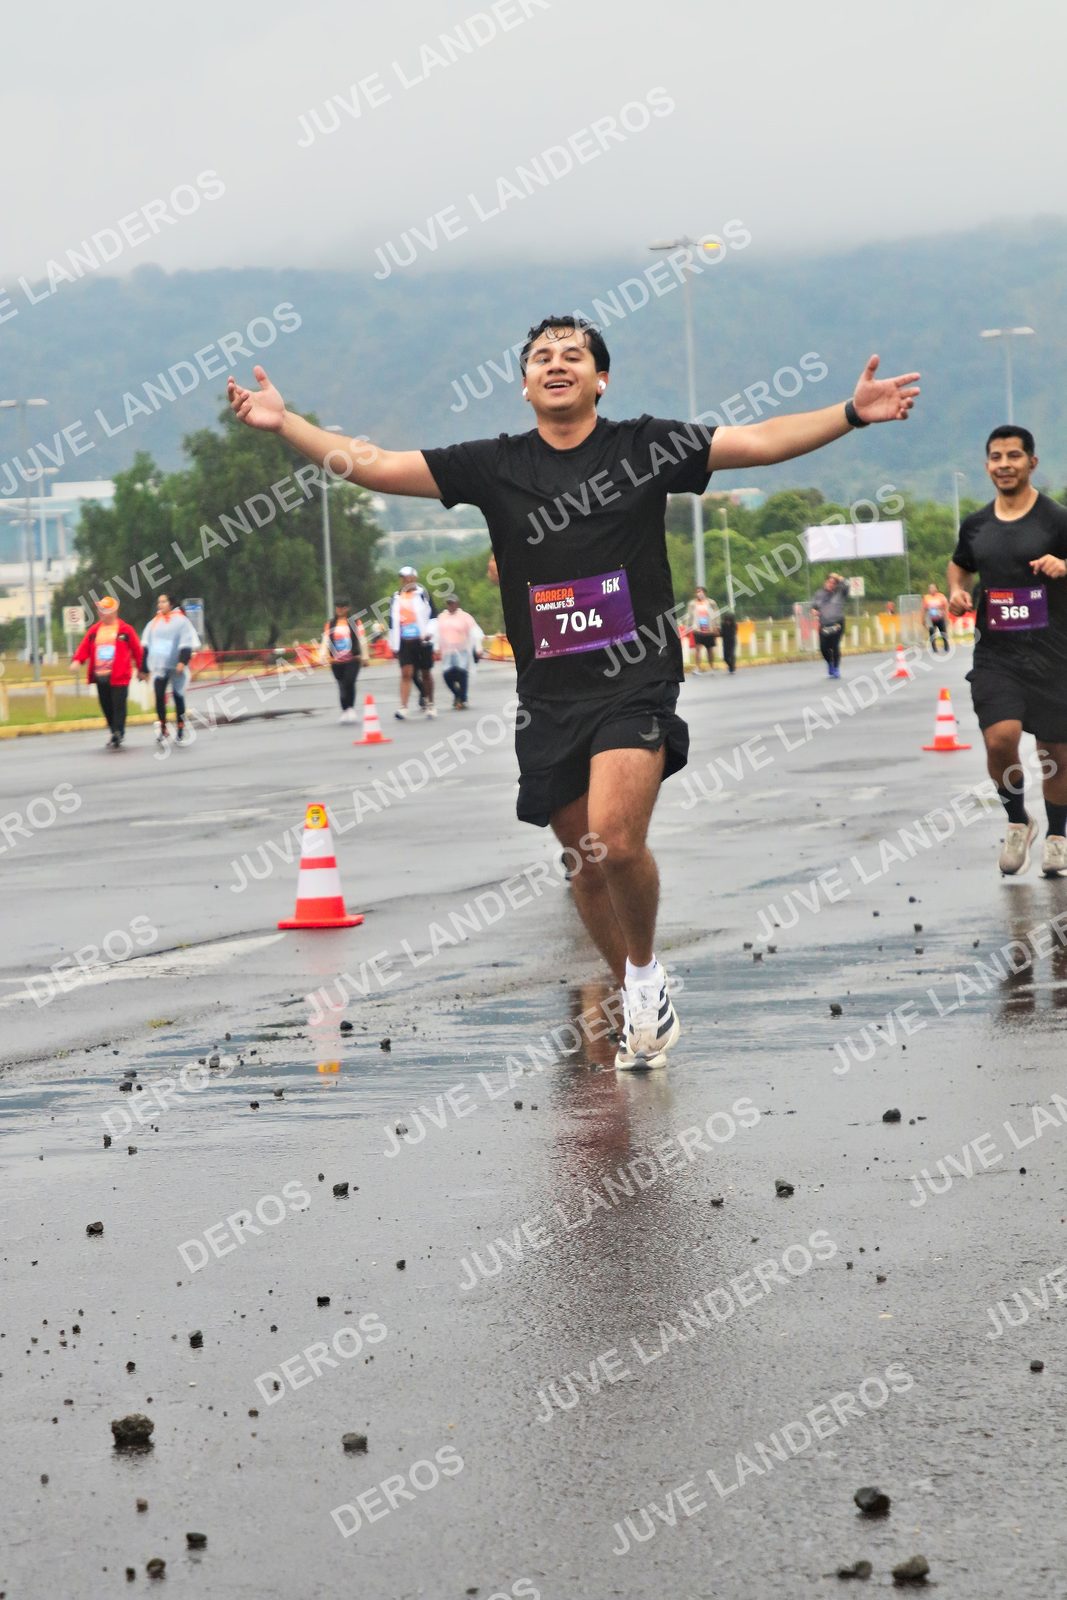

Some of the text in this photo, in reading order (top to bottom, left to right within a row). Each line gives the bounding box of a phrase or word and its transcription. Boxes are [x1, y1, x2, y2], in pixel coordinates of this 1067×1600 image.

[535, 588, 574, 603] CARRERA
[1001, 605, 1029, 619] 368
[556, 608, 603, 634] 704
